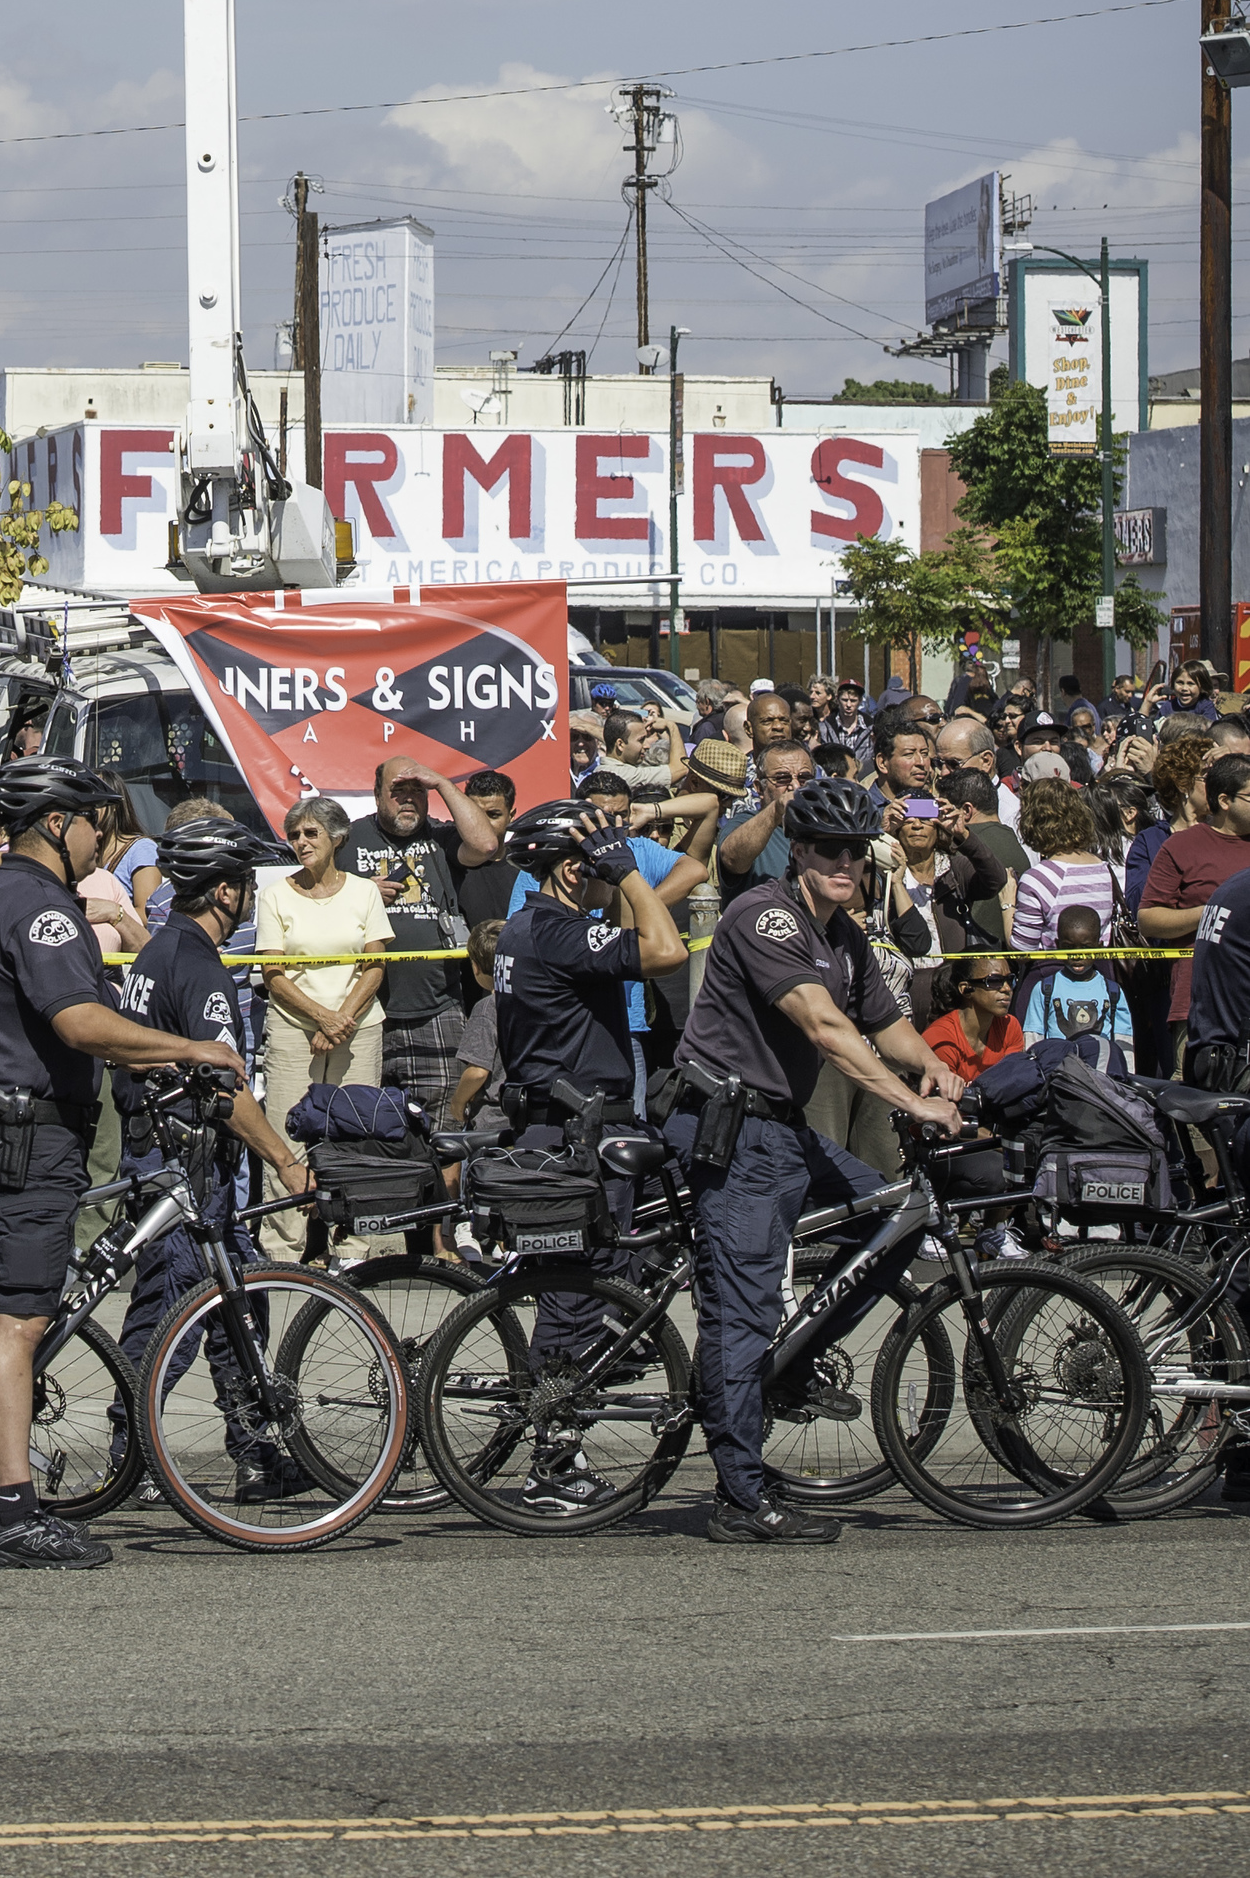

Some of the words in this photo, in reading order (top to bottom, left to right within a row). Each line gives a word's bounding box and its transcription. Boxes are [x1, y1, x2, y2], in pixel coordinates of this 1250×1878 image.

[331, 240, 386, 283] FRESH
[320, 284, 396, 329] PRODUCE
[334, 330, 381, 371] DAILY
[1055, 375, 1088, 391] Dine
[1066, 392, 1077, 406] &
[1049, 406, 1094, 427] Enjoy!
[100, 430, 883, 542] FRMERS
[387, 560, 522, 584] AMERICA
[371, 666, 404, 711] &
[427, 663, 559, 711] SIGNS
[50, 763, 77, 778] GIRO
[213, 837, 238, 849] GIRO
[759, 917, 770, 930] LOS
[768, 911, 797, 930] ANGELES
[40, 932, 70, 944] POLICE
[767, 928, 792, 937] POLICE
[1086, 1184, 1140, 1200] POLICE
[521, 1234, 578, 1251] POLICE
[806, 1245, 890, 1318] GIANT
